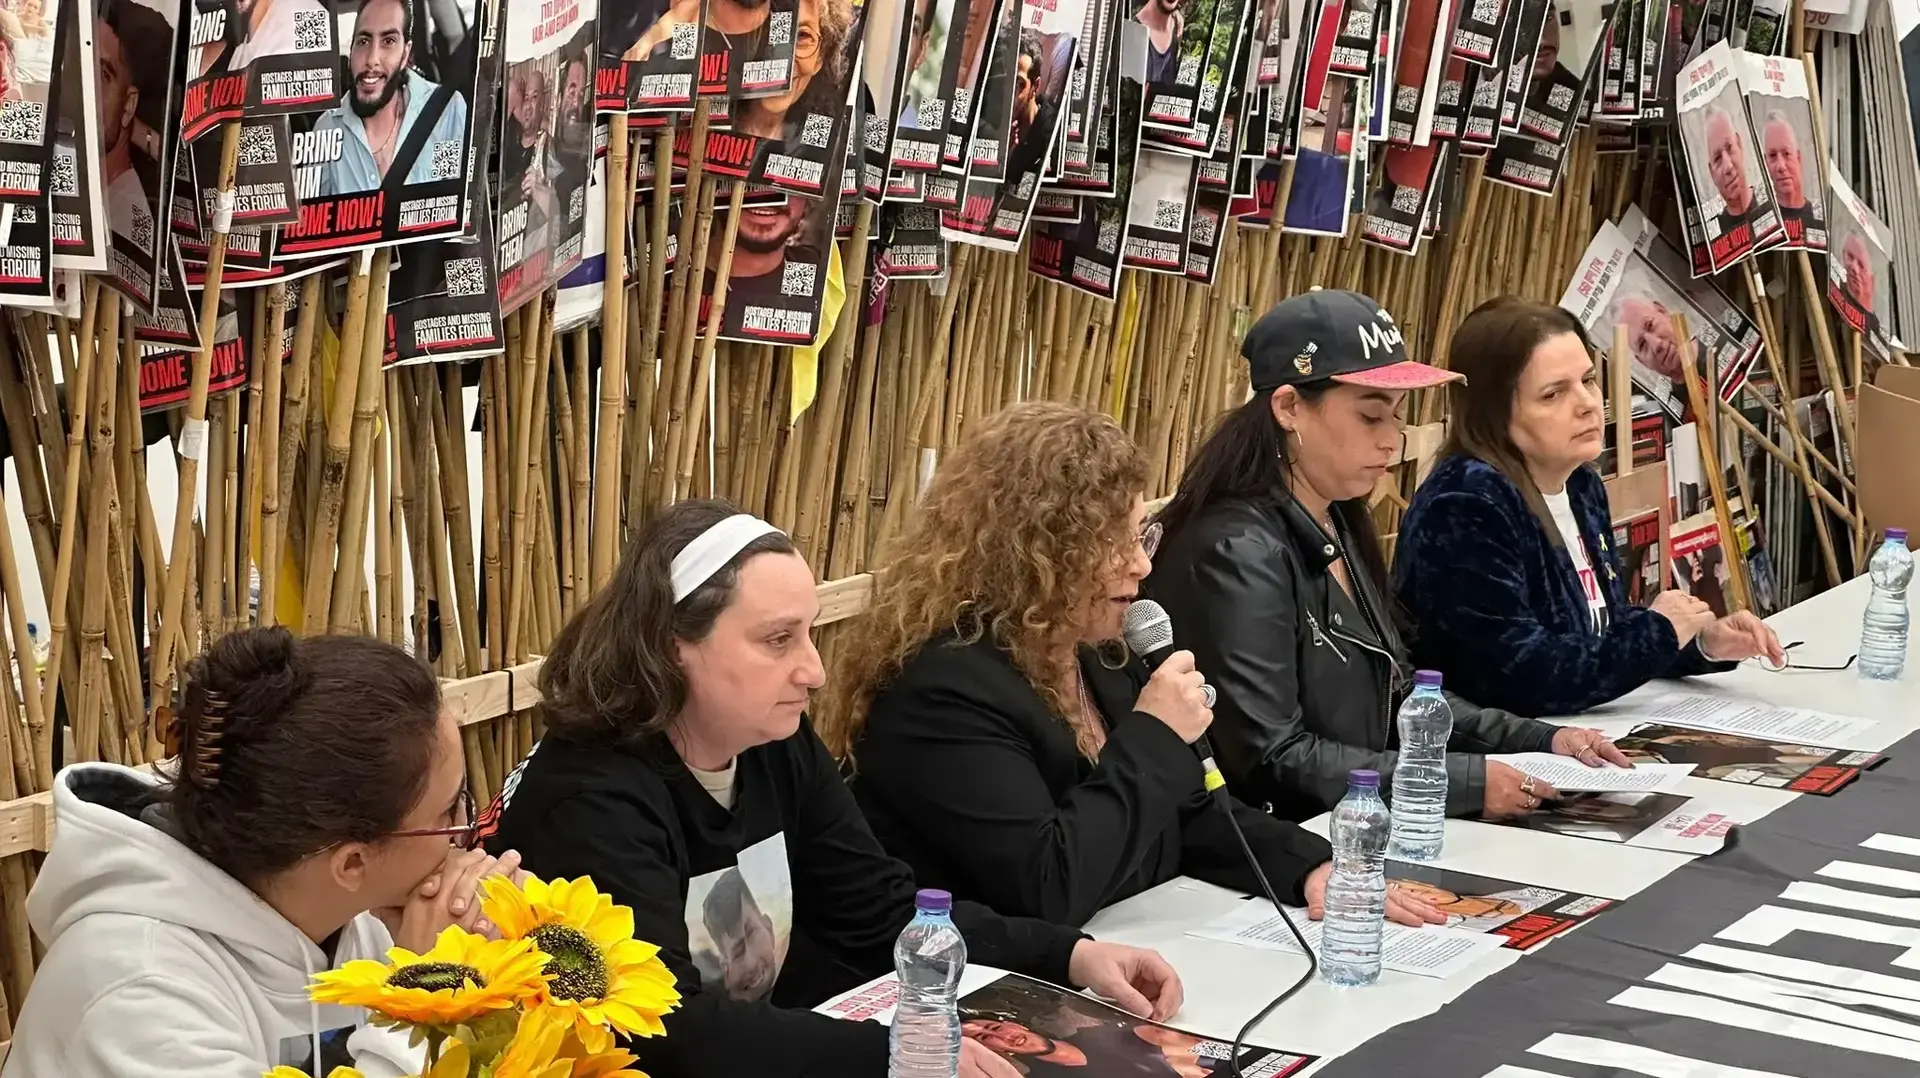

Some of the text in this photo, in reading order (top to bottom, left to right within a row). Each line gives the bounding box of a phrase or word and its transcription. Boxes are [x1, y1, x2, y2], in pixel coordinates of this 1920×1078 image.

[189, 9, 227, 46] RING
[1468, 41, 1493, 56] FORUM
[187, 47, 204, 82] IM
[1346, 53, 1368, 67] FORUM
[261, 67, 333, 85] HOSTAGES AND MISSING
[596, 62, 629, 96] OW!
[742, 67, 788, 85] FAMILIES FORUM
[261, 79, 334, 100] FAMILIES FORUM
[637, 82, 691, 98] FAMILIES FORUM
[292, 127, 344, 166] BRING
[706, 133, 757, 167] NOW!
[974, 147, 998, 162] ORUM
[915, 149, 938, 165] FORUM
[1066, 150, 1088, 164] ORUM
[6, 160, 41, 175] MISSING
[764, 161, 795, 178] FAMILIES
[795, 167, 823, 184] FORUM
[1203, 168, 1227, 182] FORUM
[1, 172, 40, 191] FORUM
[239, 184, 253, 196] AND
[253, 181, 285, 195] MISSING
[930, 185, 957, 201] FORUM
[251, 194, 288, 211] FORUM
[400, 194, 459, 212] HOSTAGES AND MISSING
[335, 191, 385, 233] NOW!
[399, 209, 432, 228] FAMILIES
[431, 206, 458, 223] FORUM
[501, 200, 528, 242] BRING
[52, 224, 82, 241] ORUM
[1388, 228, 1411, 244] FORUM
[6, 245, 41, 259] MISSING
[500, 232, 524, 273] THEM
[891, 253, 937, 267] LIES FORUM
[1125, 244, 1179, 263] AMILIES FORUM
[2, 259, 41, 278] FORUM
[414, 312, 492, 331] HOSTAGES AND MISSING
[744, 306, 812, 323] HOSTAGES AND MISSING
[415, 324, 458, 346] FAMILIES
[458, 322, 493, 342] FORUM
[743, 316, 811, 335] FAMILIES FORUM
